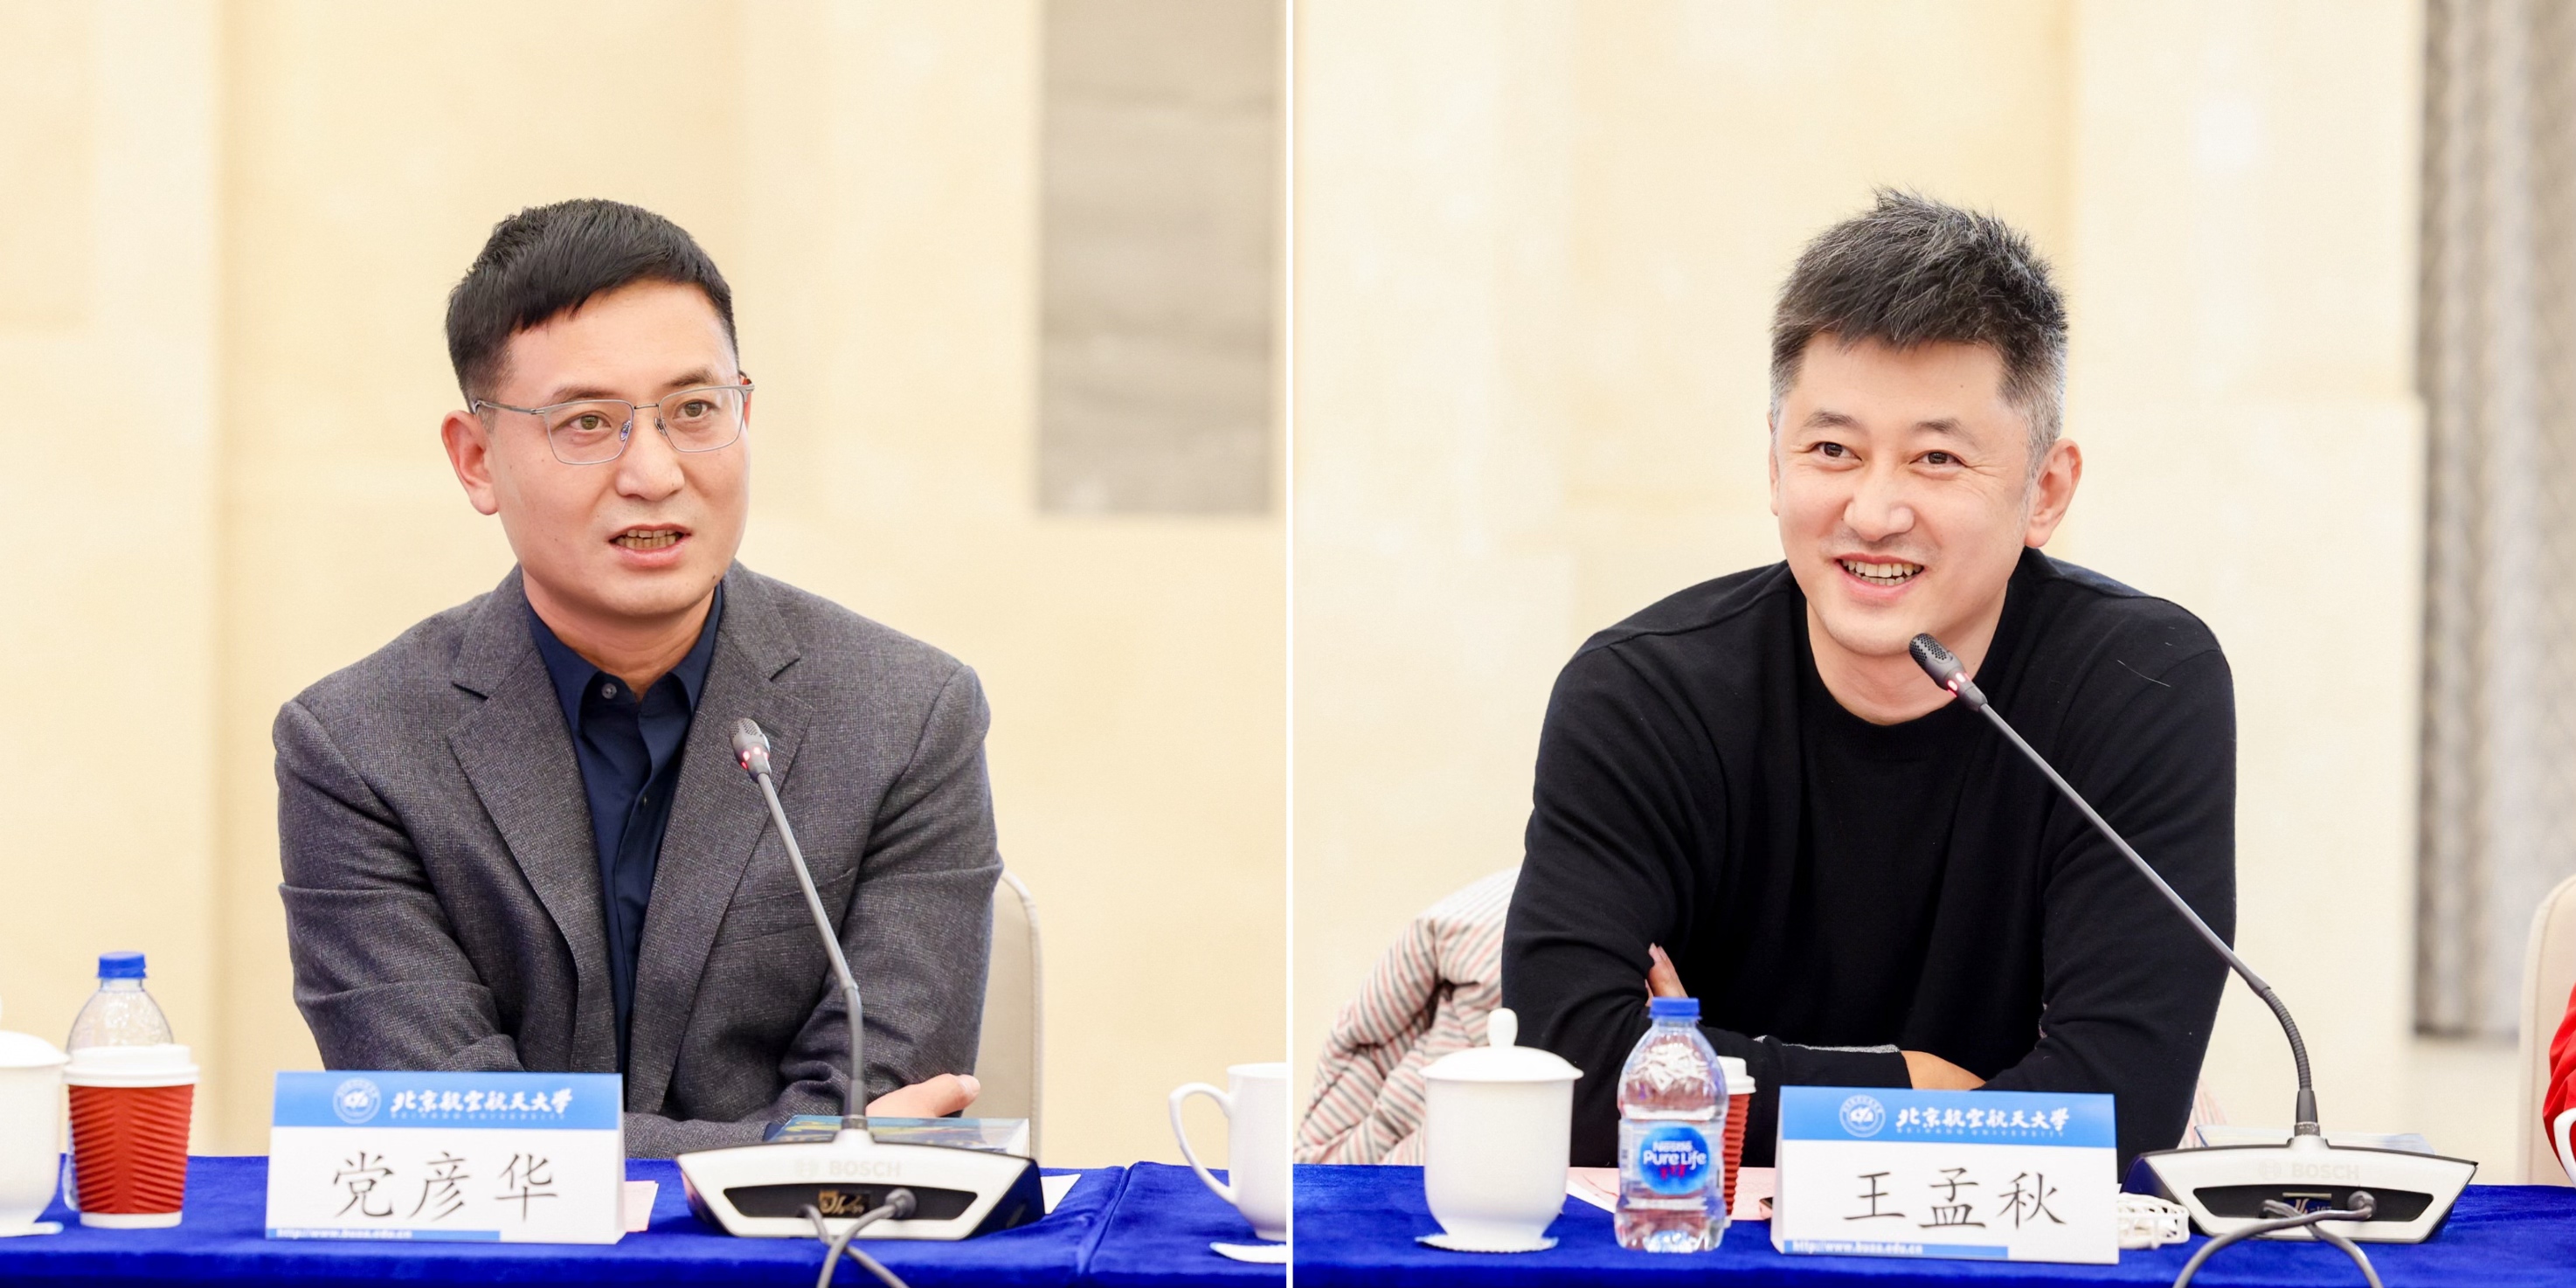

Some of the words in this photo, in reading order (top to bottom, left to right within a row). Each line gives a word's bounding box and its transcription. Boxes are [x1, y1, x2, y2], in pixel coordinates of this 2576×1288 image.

[829, 1160, 903, 1178] BOSCH
[1643, 1150, 1679, 1165] Pure
[1681, 1151, 1707, 1170] Life
[2291, 1162, 2360, 1180] BOSCH
[332, 1150, 559, 1222] 党彦华
[1843, 1167, 2068, 1231] 王孟秋
